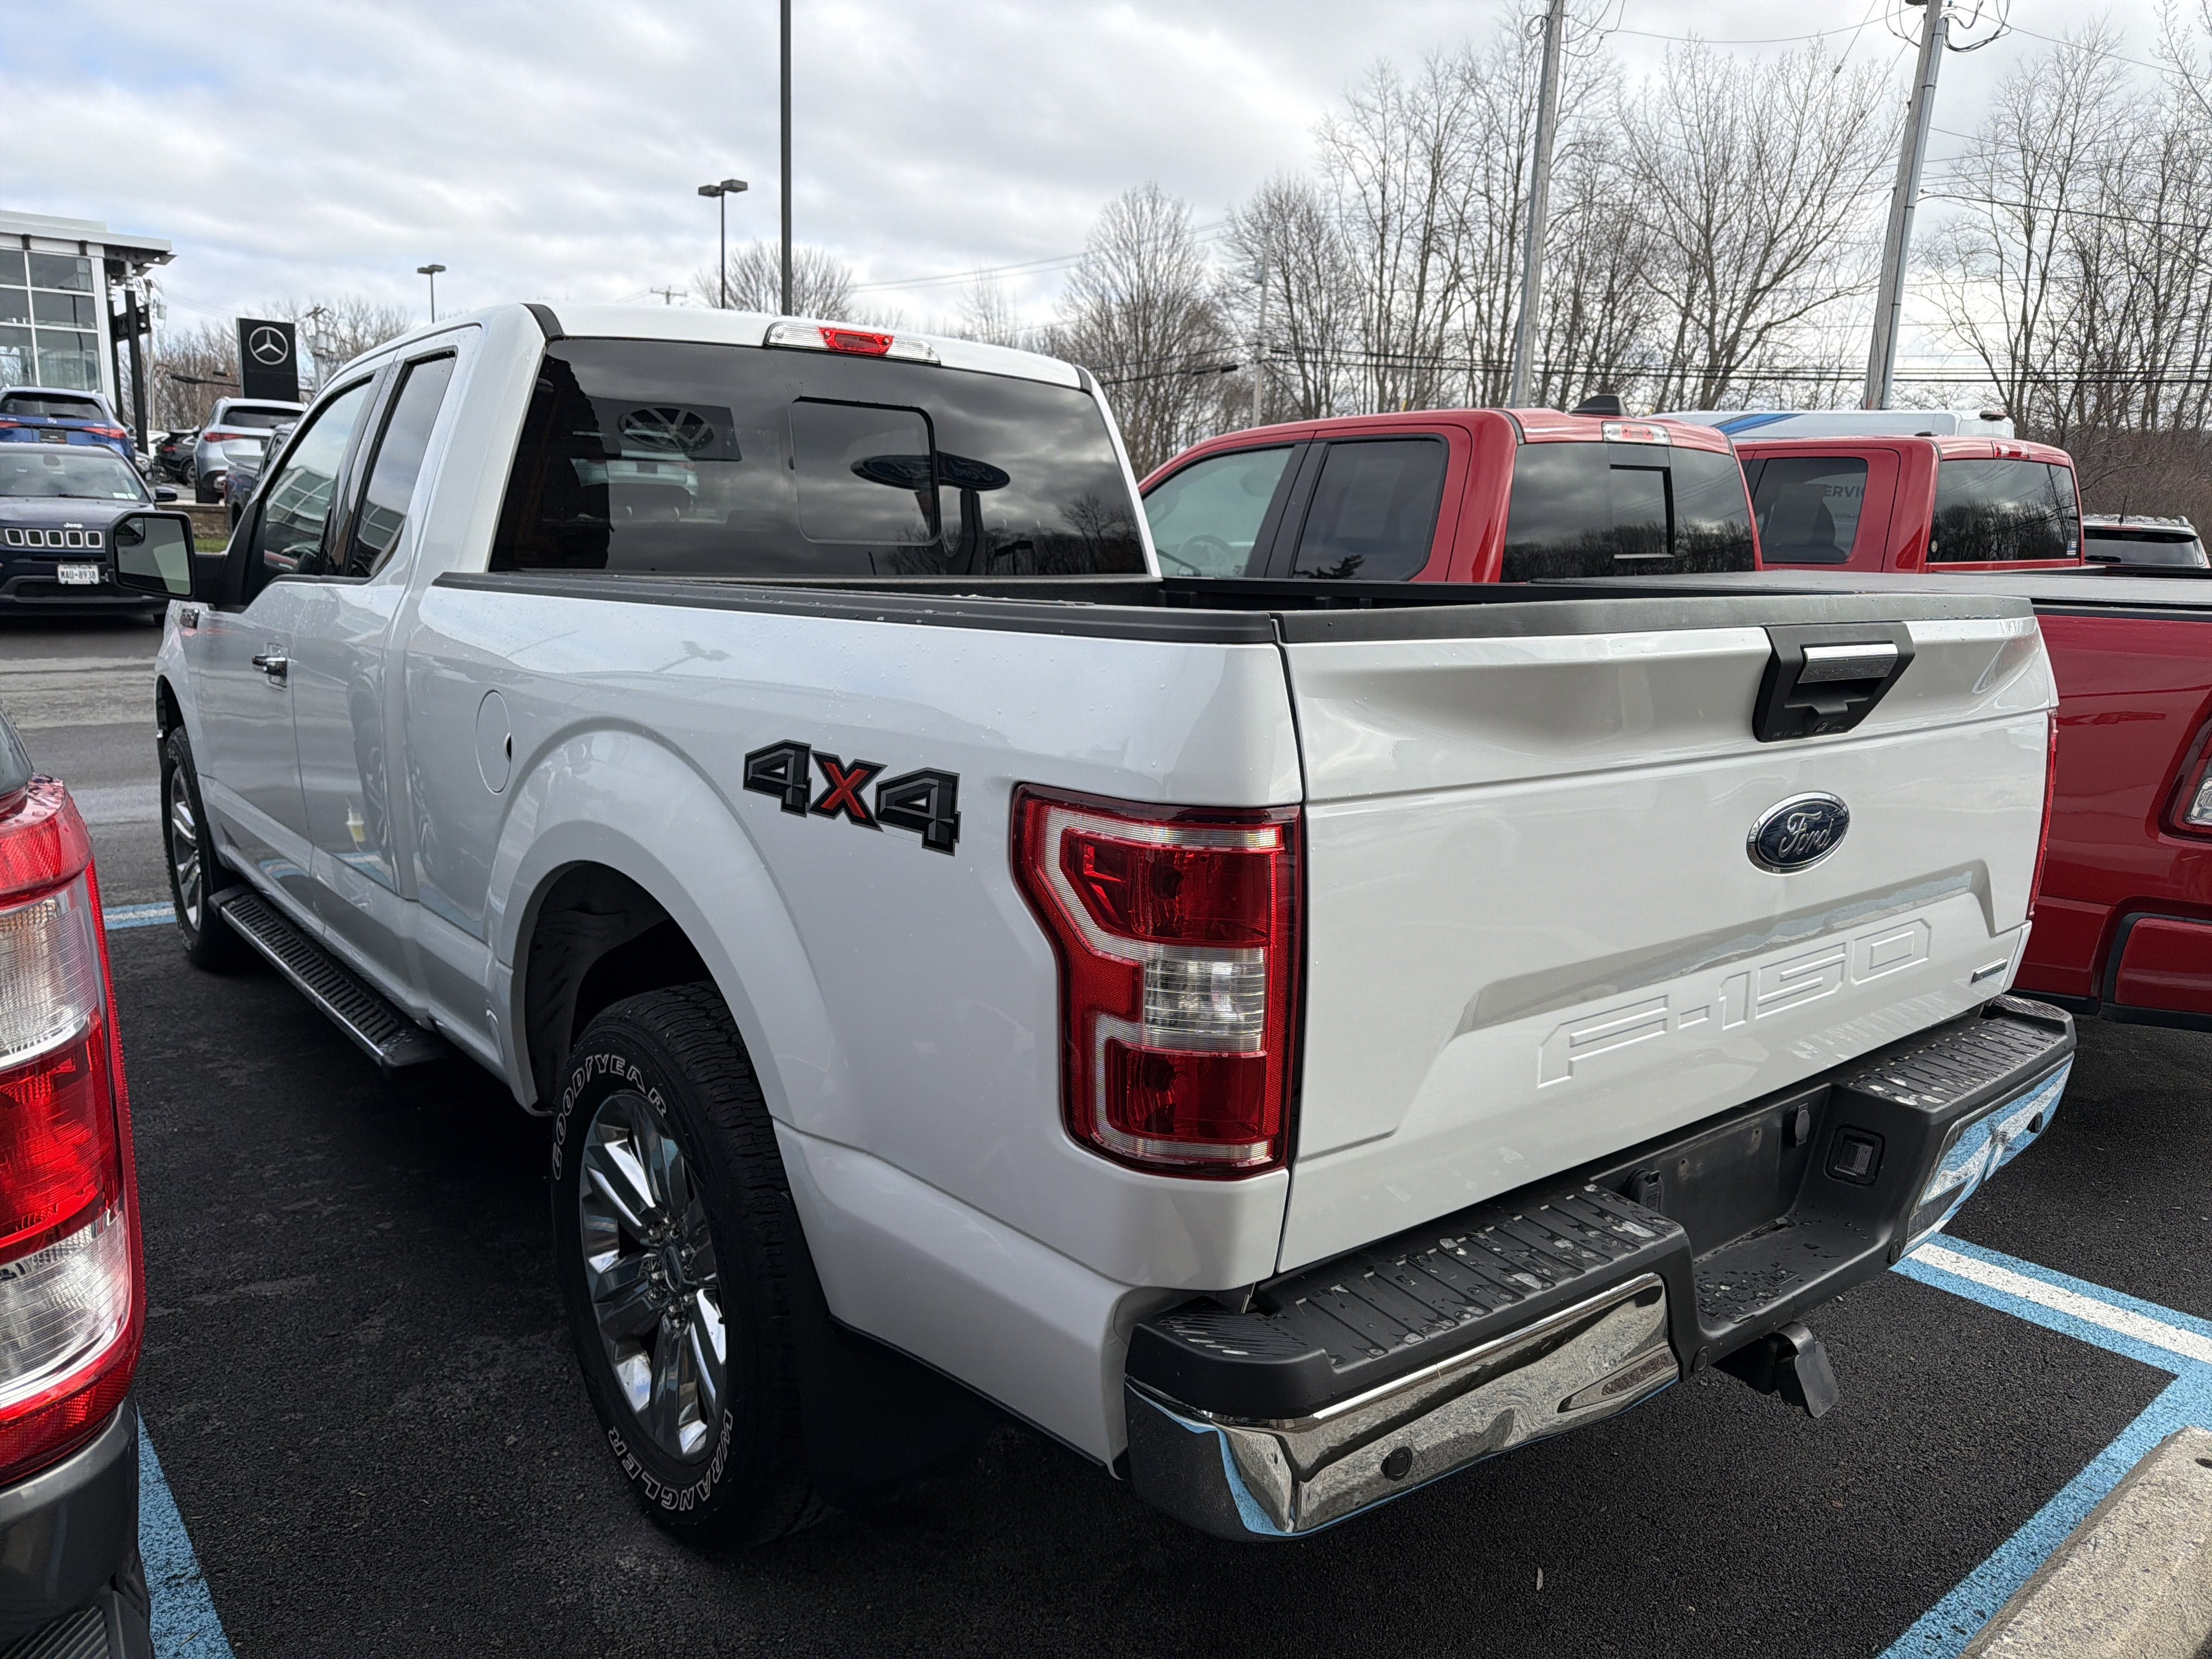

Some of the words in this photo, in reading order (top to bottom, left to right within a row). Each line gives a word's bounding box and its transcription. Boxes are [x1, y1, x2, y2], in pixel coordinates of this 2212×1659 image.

[1824, 486, 1864, 498] ERVI
[1778, 811, 1835, 858] Ford
[1537, 918, 1932, 1088] F-150
[552, 1053, 667, 1180] GOODYEAR
[608, 1408, 733, 1511] WRANGLER
